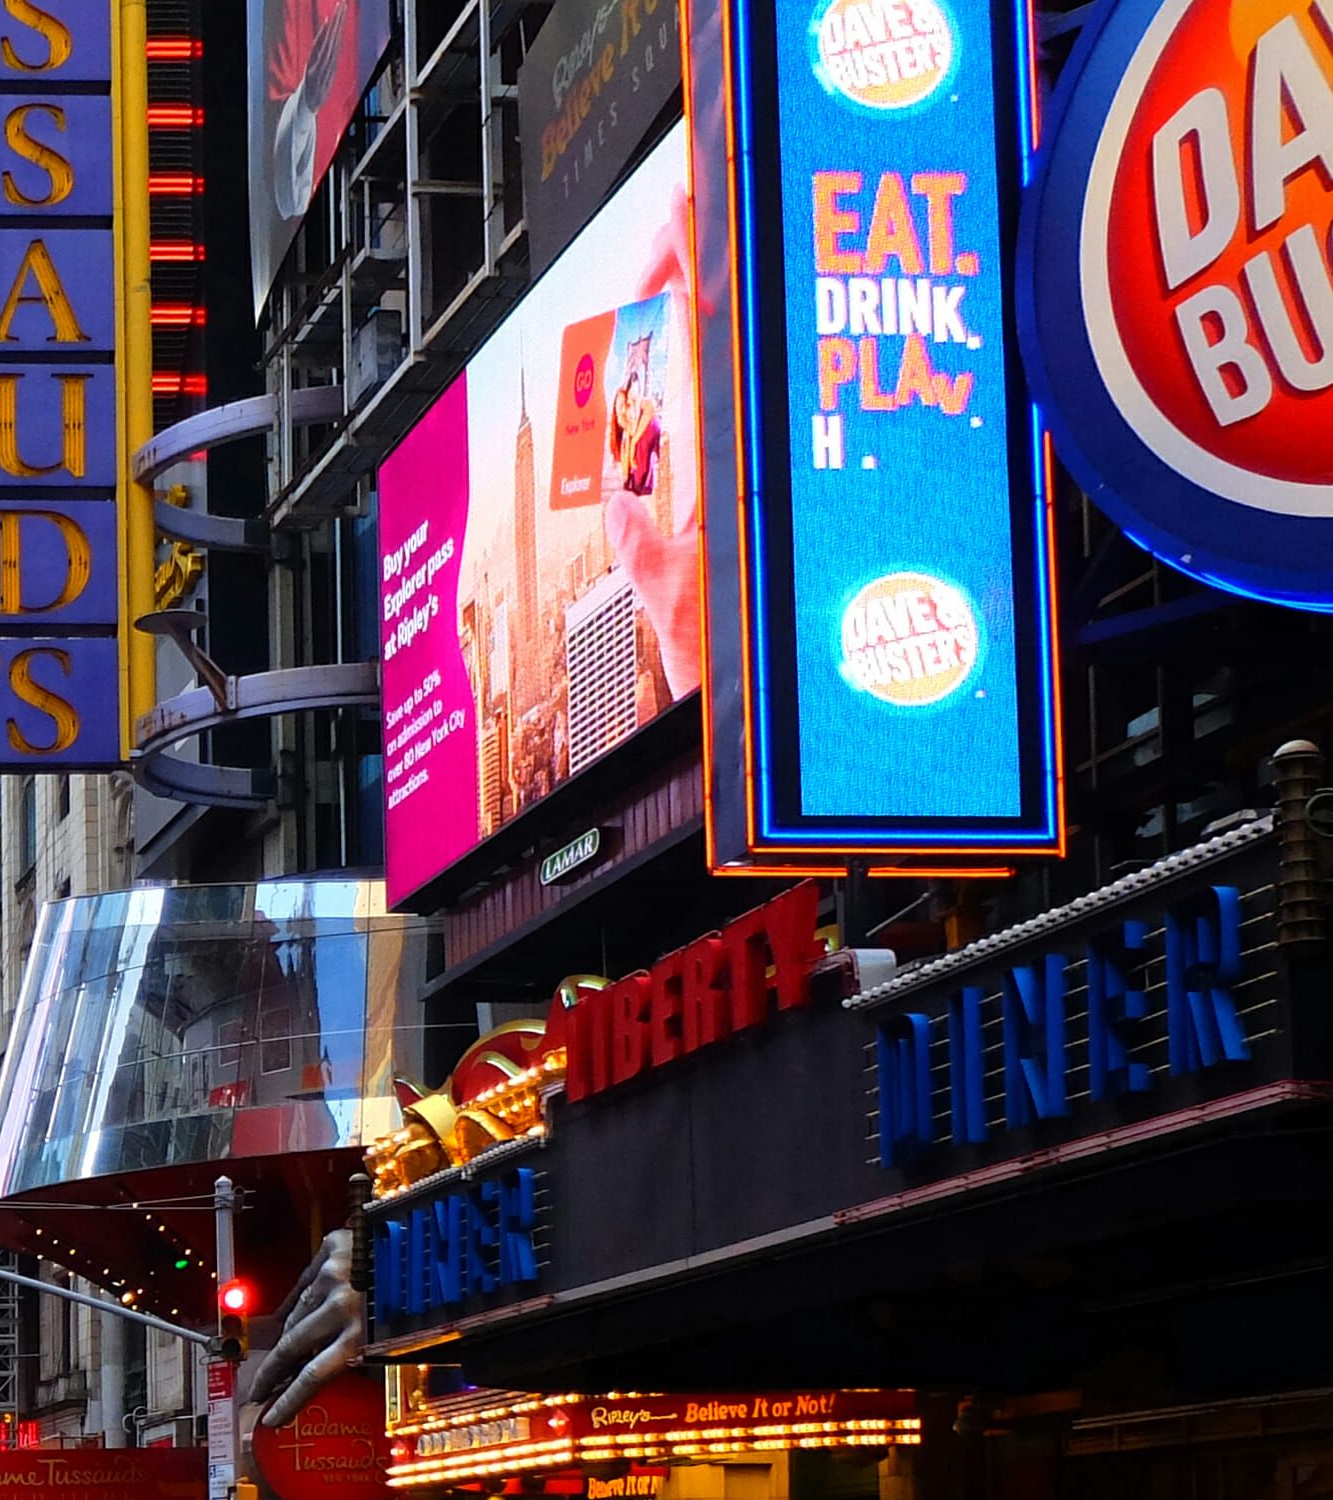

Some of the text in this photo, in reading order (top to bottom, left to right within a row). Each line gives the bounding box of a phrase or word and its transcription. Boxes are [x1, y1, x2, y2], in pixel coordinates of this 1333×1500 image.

[1153, 0, 1333, 290] DA
[812, 170, 980, 275] EAT.
[815, 277, 983, 349] DRINK.
[383, 520, 430, 583] Buy your
[383, 537, 455, 622] Explorer pass
[384, 593, 440, 662] at Ripley's
[543, 833, 596, 880] LAMAR
[566, 877, 827, 1104] LIBERTY
[875, 885, 1253, 1171] DINER
[373, 1166, 537, 1323] DINER
[684, 1401, 748, 1423] Believe
[751, 1398, 770, 1418] It
[771, 1402, 793, 1418] or
[794, 1393, 836, 1417] Not!
[37, 1453, 148, 1487] Tussauds
[277, 1438, 390, 1473] Tussauds
